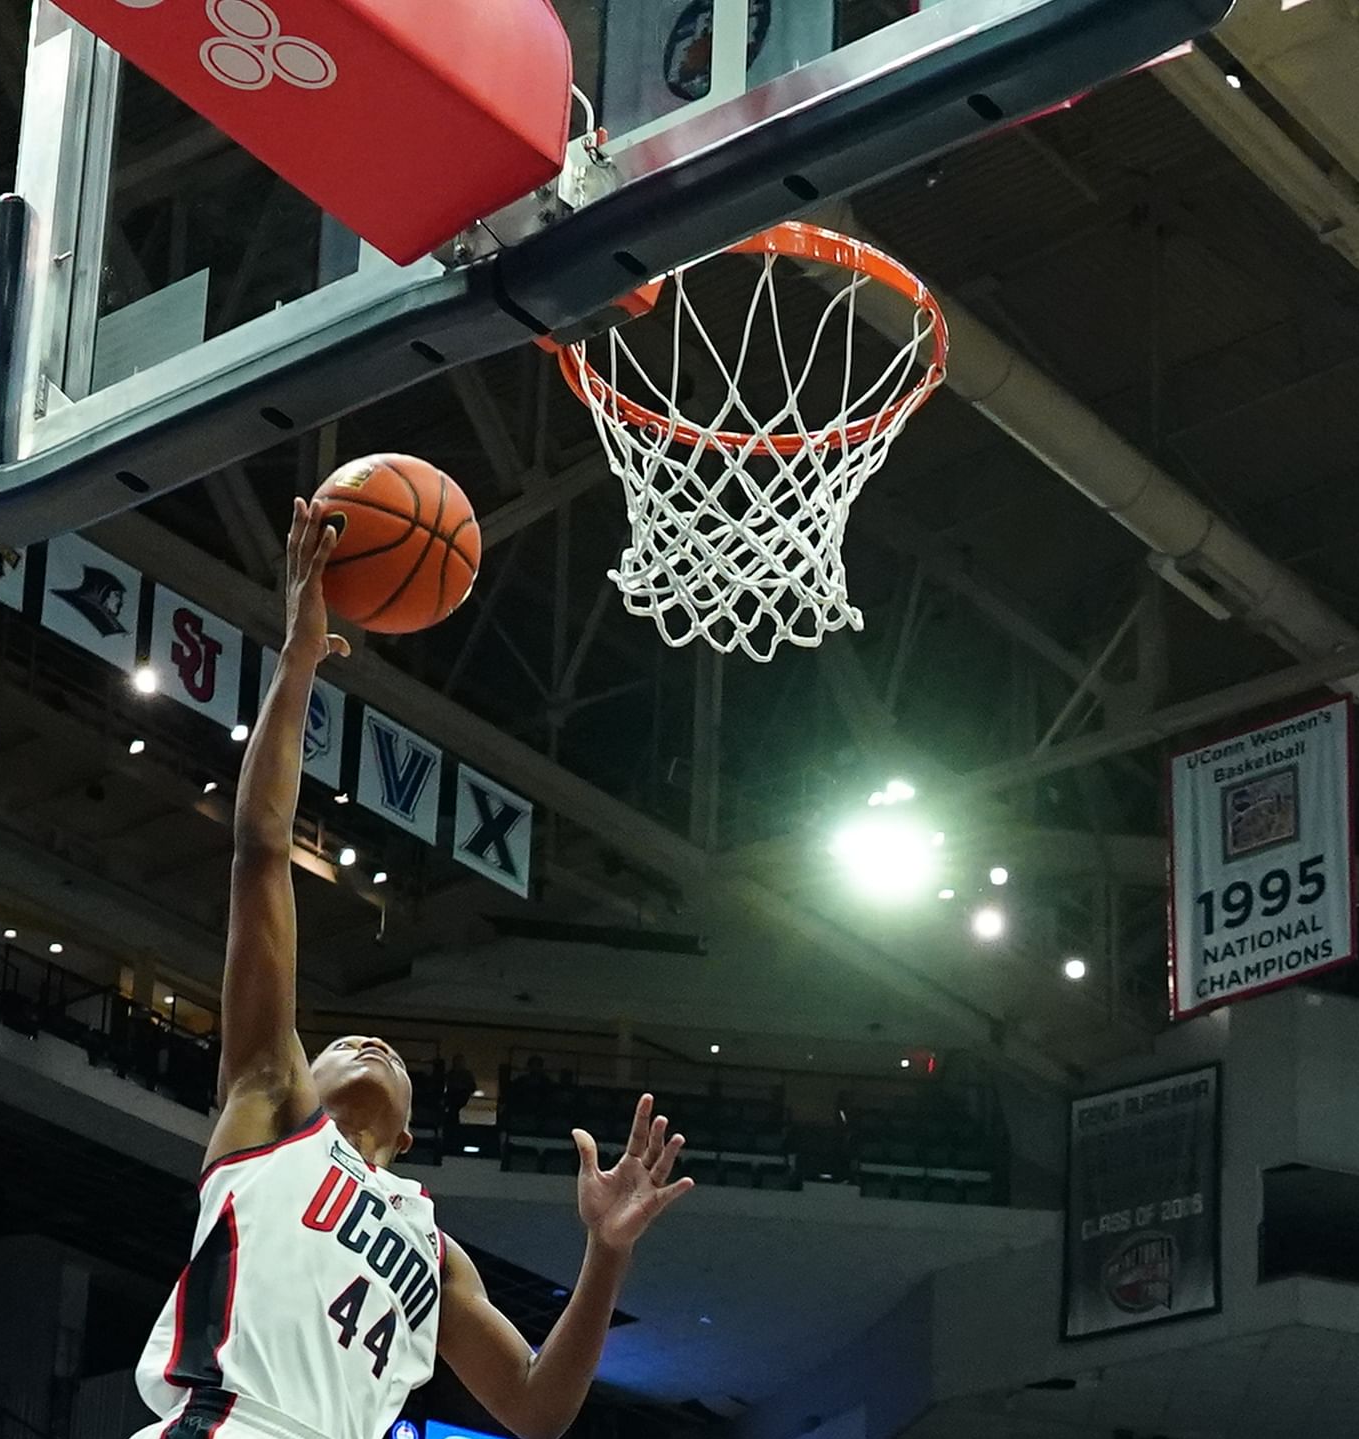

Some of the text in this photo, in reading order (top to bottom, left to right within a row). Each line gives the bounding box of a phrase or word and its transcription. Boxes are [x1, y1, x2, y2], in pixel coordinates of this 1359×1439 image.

[1187, 710, 1332, 770] UConn Women's
[1214, 740, 1306, 783] Basketball
[1196, 854, 1326, 936] 1995
[1196, 939, 1333, 999] CHAMPIONS
[1202, 914, 1323, 967] NATIONAL
[328, 1275, 397, 1380] 44
